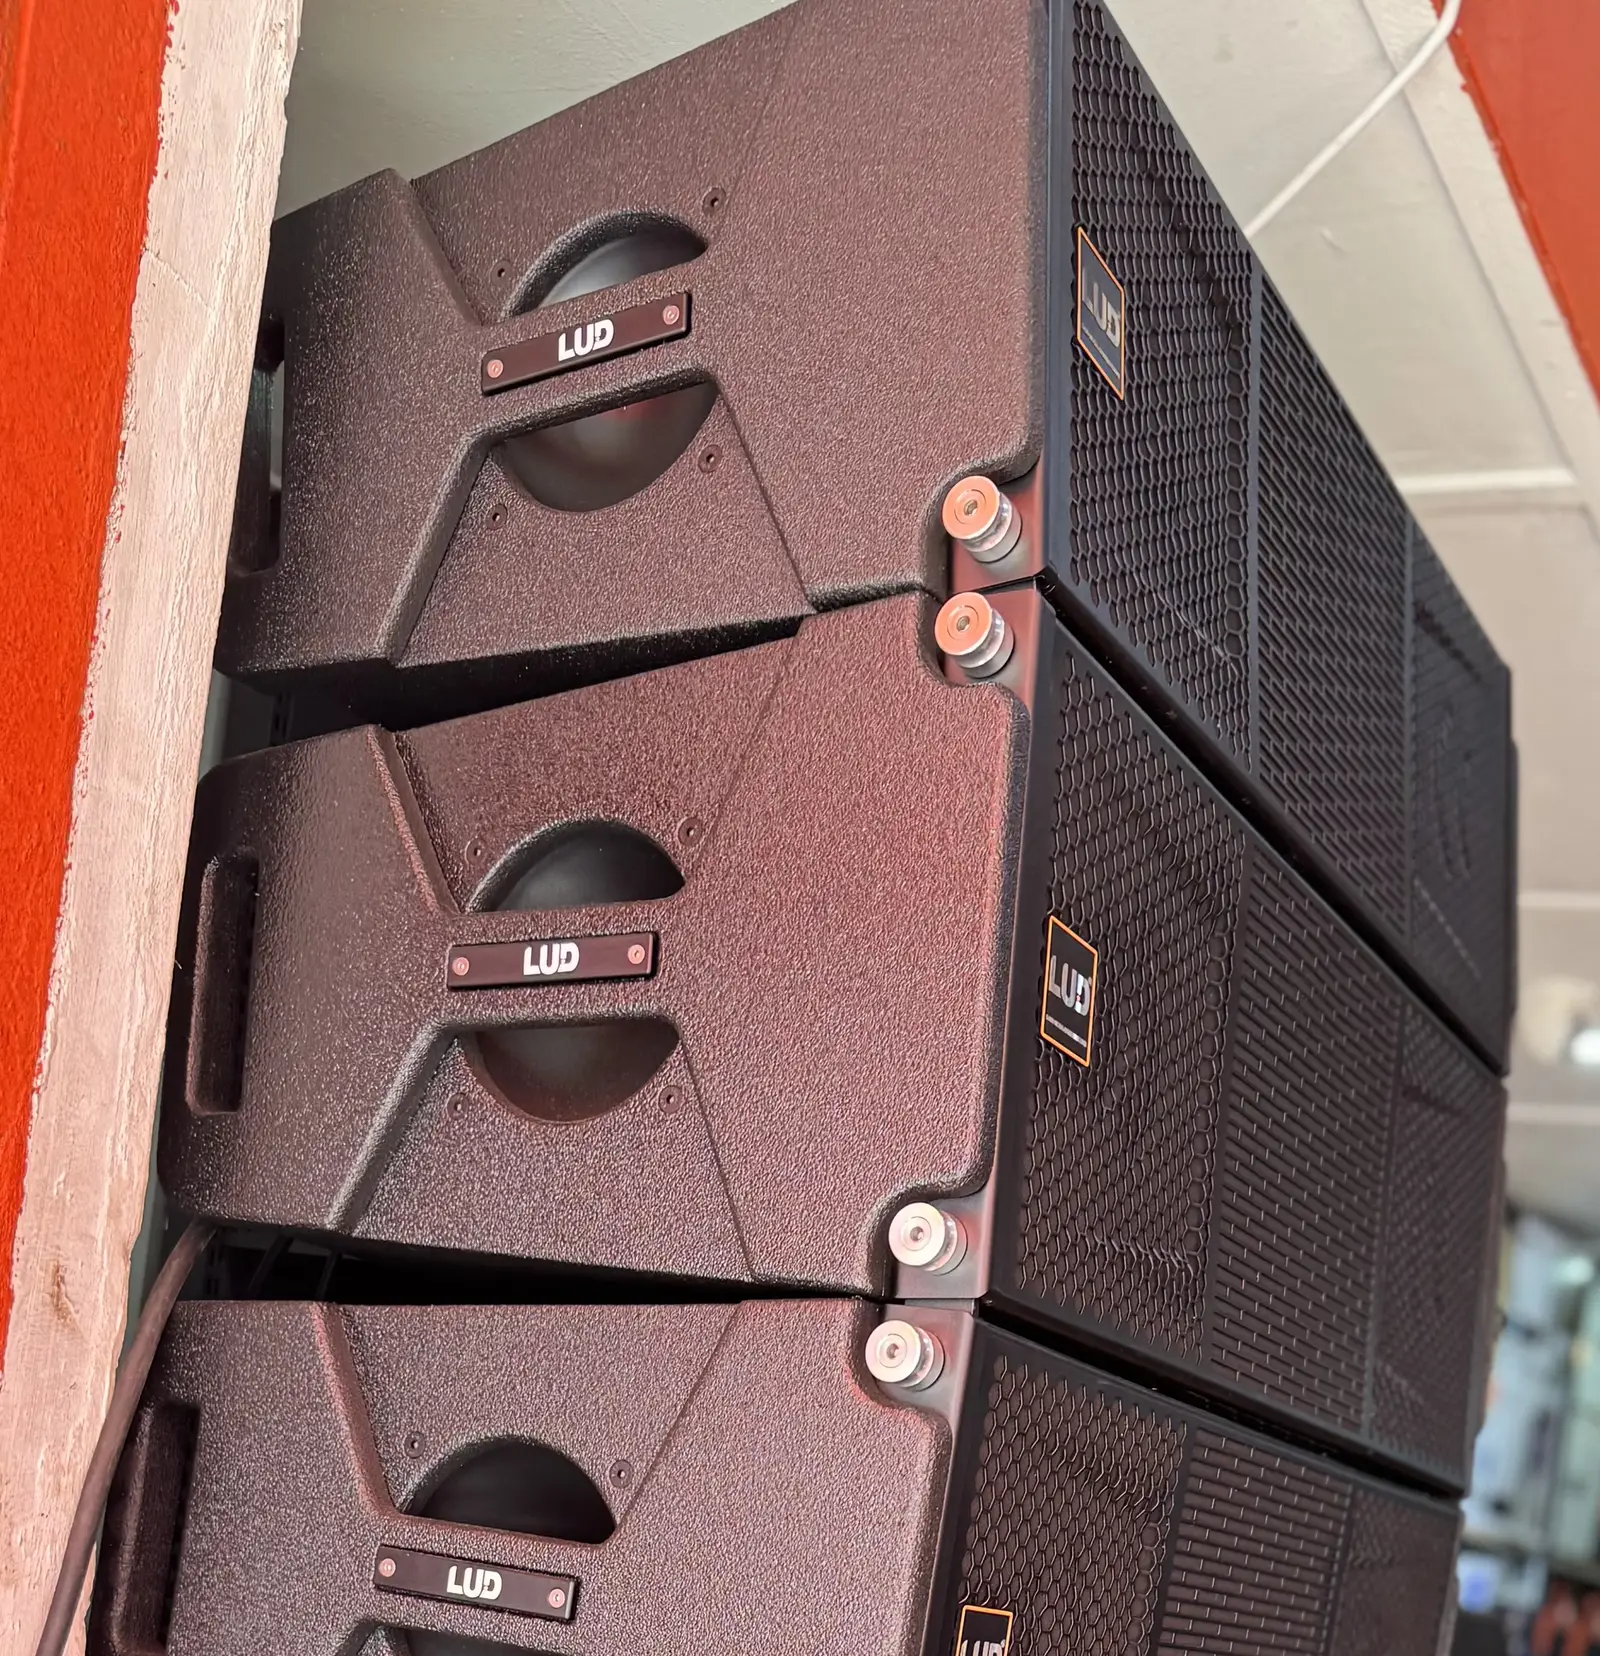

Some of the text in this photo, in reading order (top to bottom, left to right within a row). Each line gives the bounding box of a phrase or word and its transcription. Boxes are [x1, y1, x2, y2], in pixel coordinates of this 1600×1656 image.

[1082, 267, 1121, 348] LUD
[558, 319, 614, 361] LUD
[523, 942, 579, 975] LUD
[1049, 955, 1091, 1016] LUD
[446, 1565, 502, 1600] LUD
